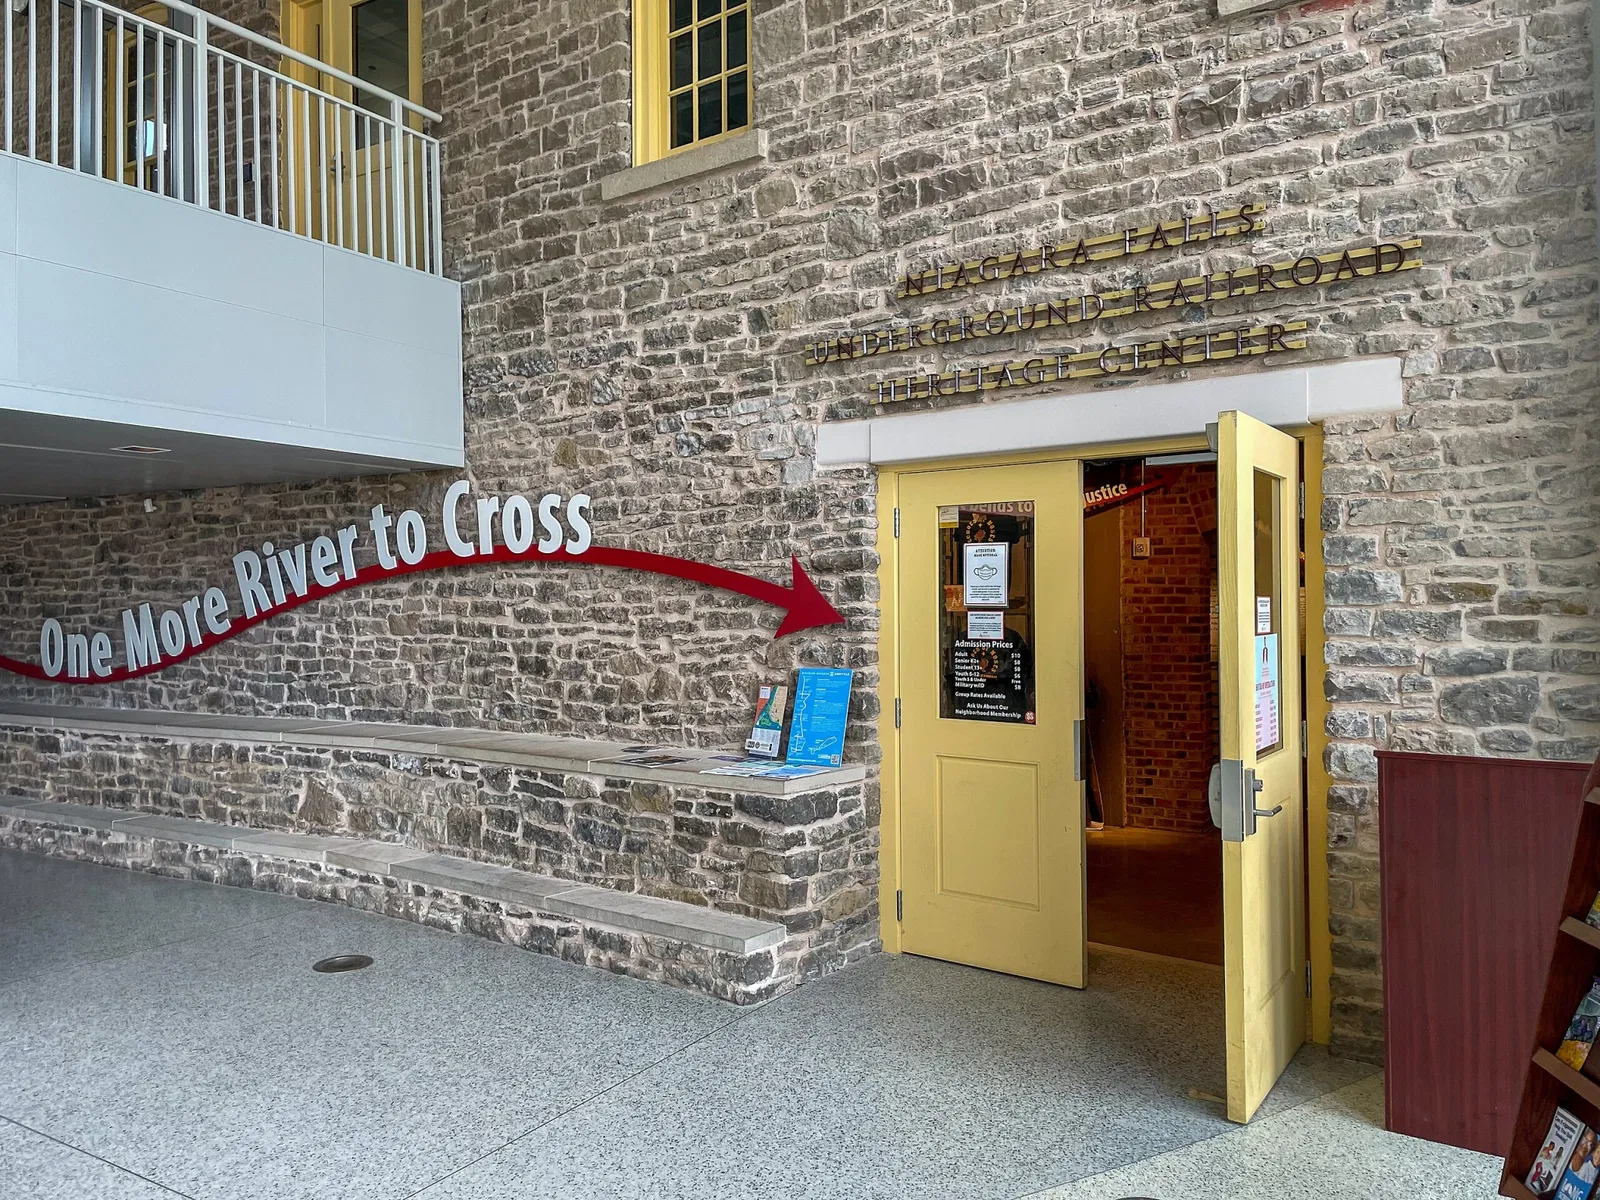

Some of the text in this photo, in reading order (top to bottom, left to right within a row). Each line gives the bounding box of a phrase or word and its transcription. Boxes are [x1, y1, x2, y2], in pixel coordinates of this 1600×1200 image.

[904, 203, 1255, 297] NIAGARA FALLS
[811, 243, 1405, 364] UNDERGROUND RAILROAD
[876, 323, 1290, 403] HERITAGE CENTER
[40, 479, 593, 679] One More River to Cross
[955, 640, 1013, 649] Admission Prices
[955, 708, 1021, 720] Neighborhood Membership
